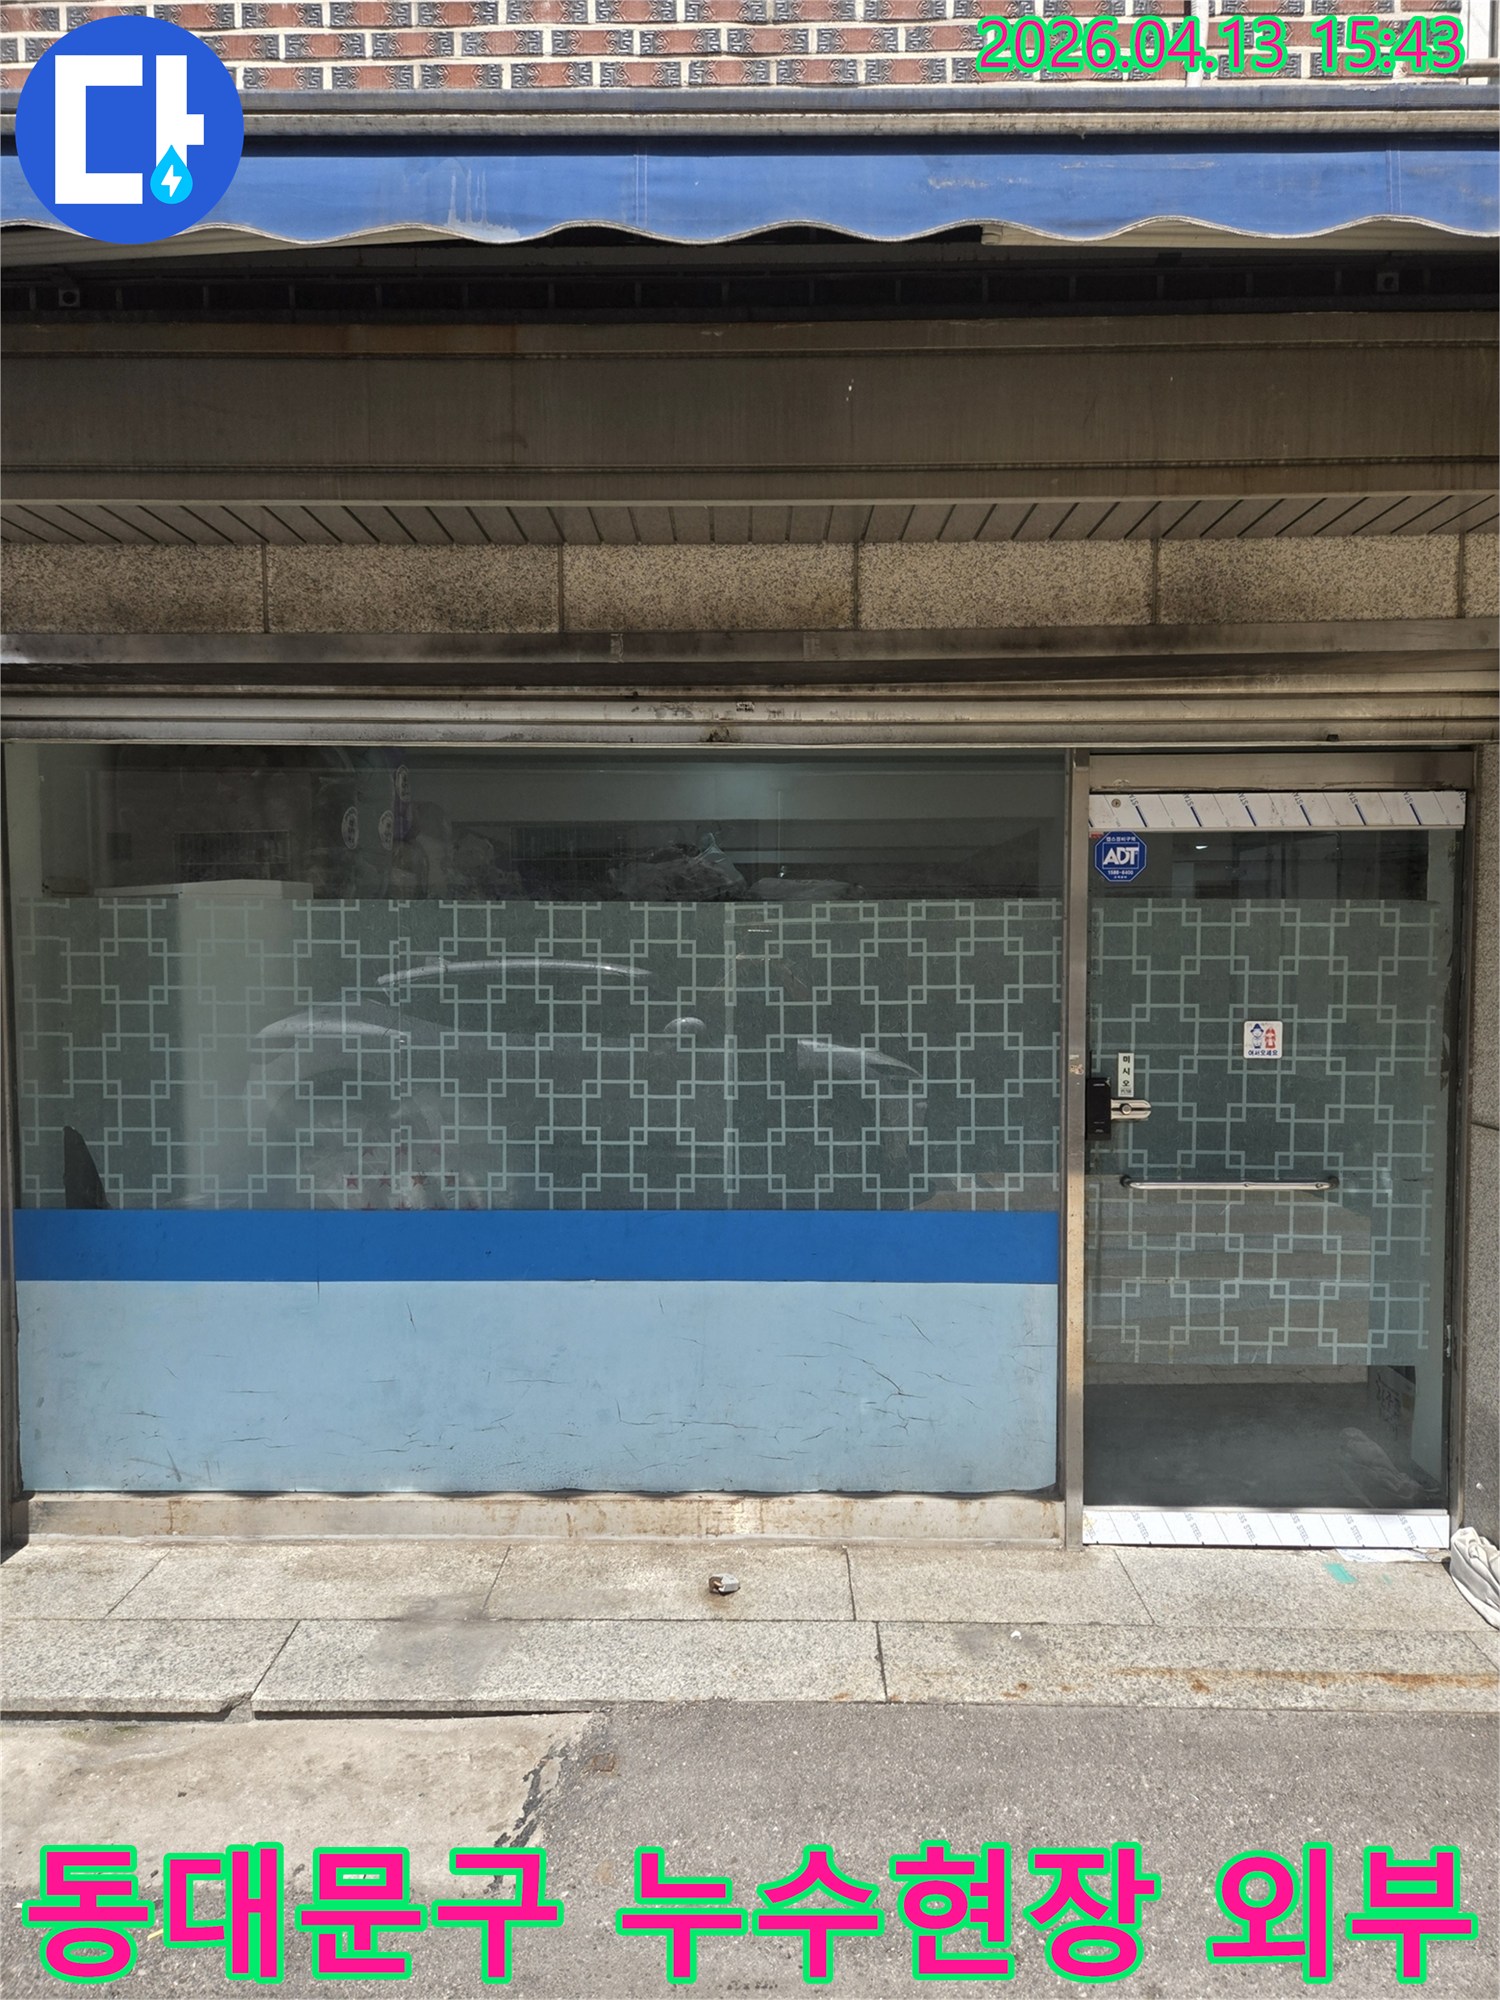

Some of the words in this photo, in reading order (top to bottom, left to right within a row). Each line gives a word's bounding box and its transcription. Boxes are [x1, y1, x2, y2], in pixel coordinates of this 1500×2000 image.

[1103, 847, 1139, 865] ADT
[1247, 1049, 1279, 1057] 어서오세요
[1122, 1055, 1131, 1087] 미시오
